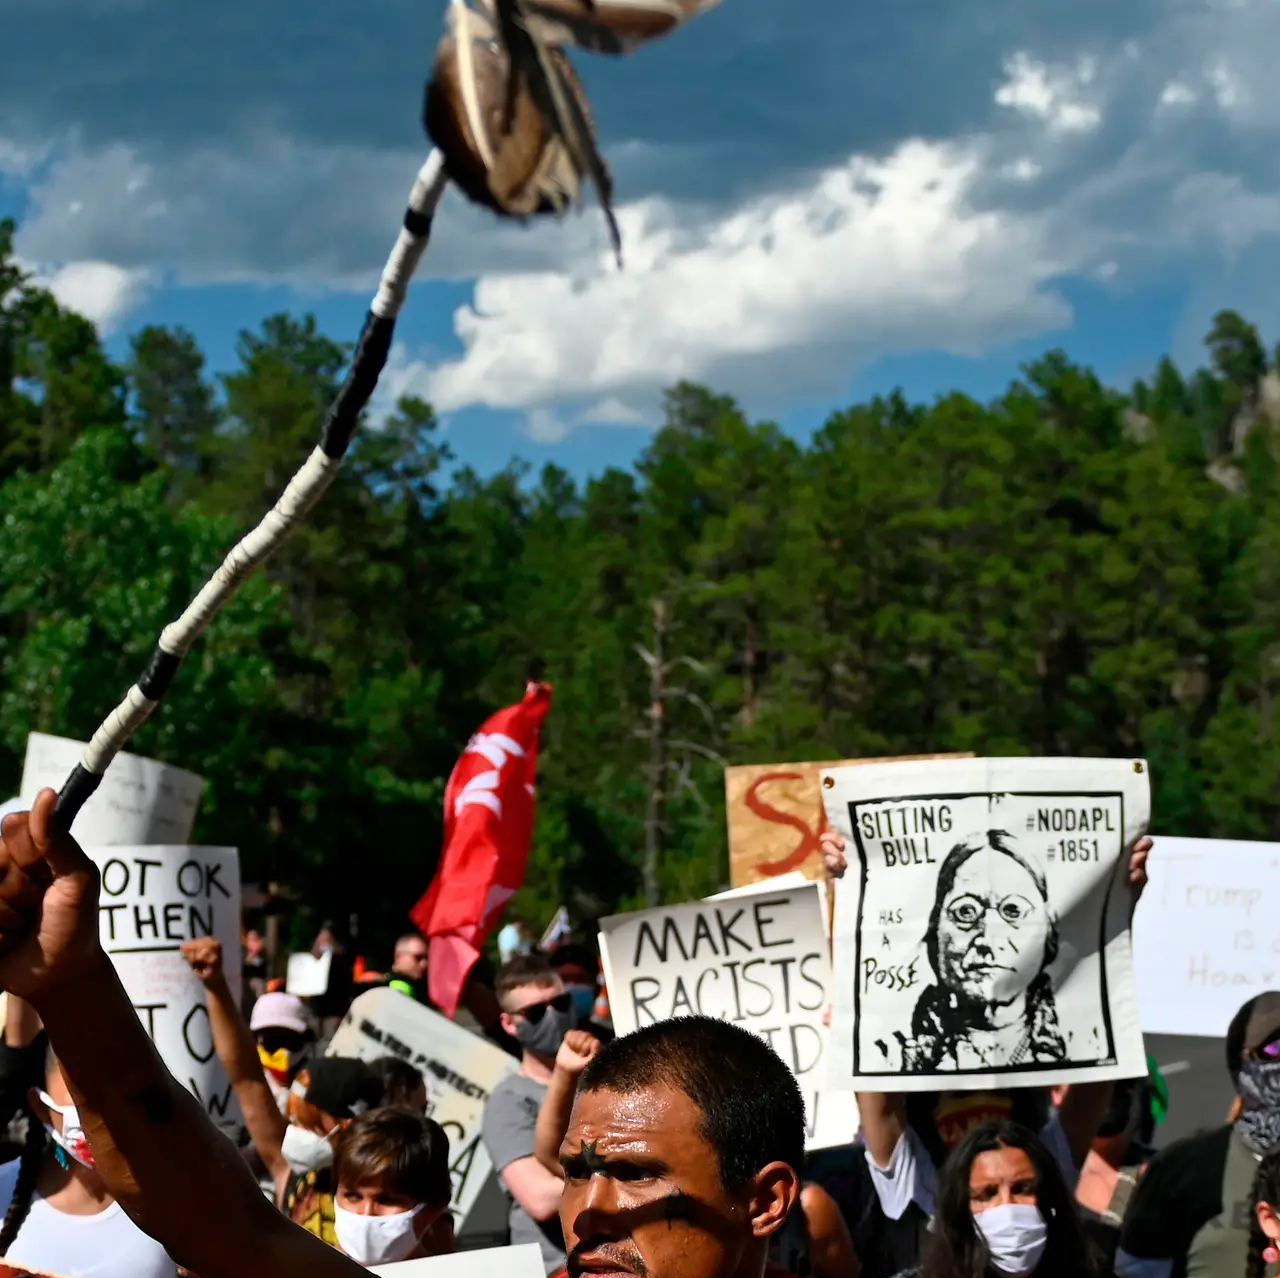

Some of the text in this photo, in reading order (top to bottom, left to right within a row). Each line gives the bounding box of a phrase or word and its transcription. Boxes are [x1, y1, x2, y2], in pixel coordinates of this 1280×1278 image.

[861, 805, 953, 840] SITTING
[1026, 807, 1116, 833] #NODAPL
[882, 837, 937, 868] BULL
[1047, 839, 1100, 862] #1851
[100, 857, 231, 899] OT OK
[1148, 853, 1263, 918] Trump
[98, 903, 215, 941] THEN
[633, 898, 795, 968] MAKE
[879, 908, 903, 926] HAS
[882, 932, 891, 951] A
[629, 952, 826, 1030] RACISTS
[415, 1054, 491, 1102] PROTECT
